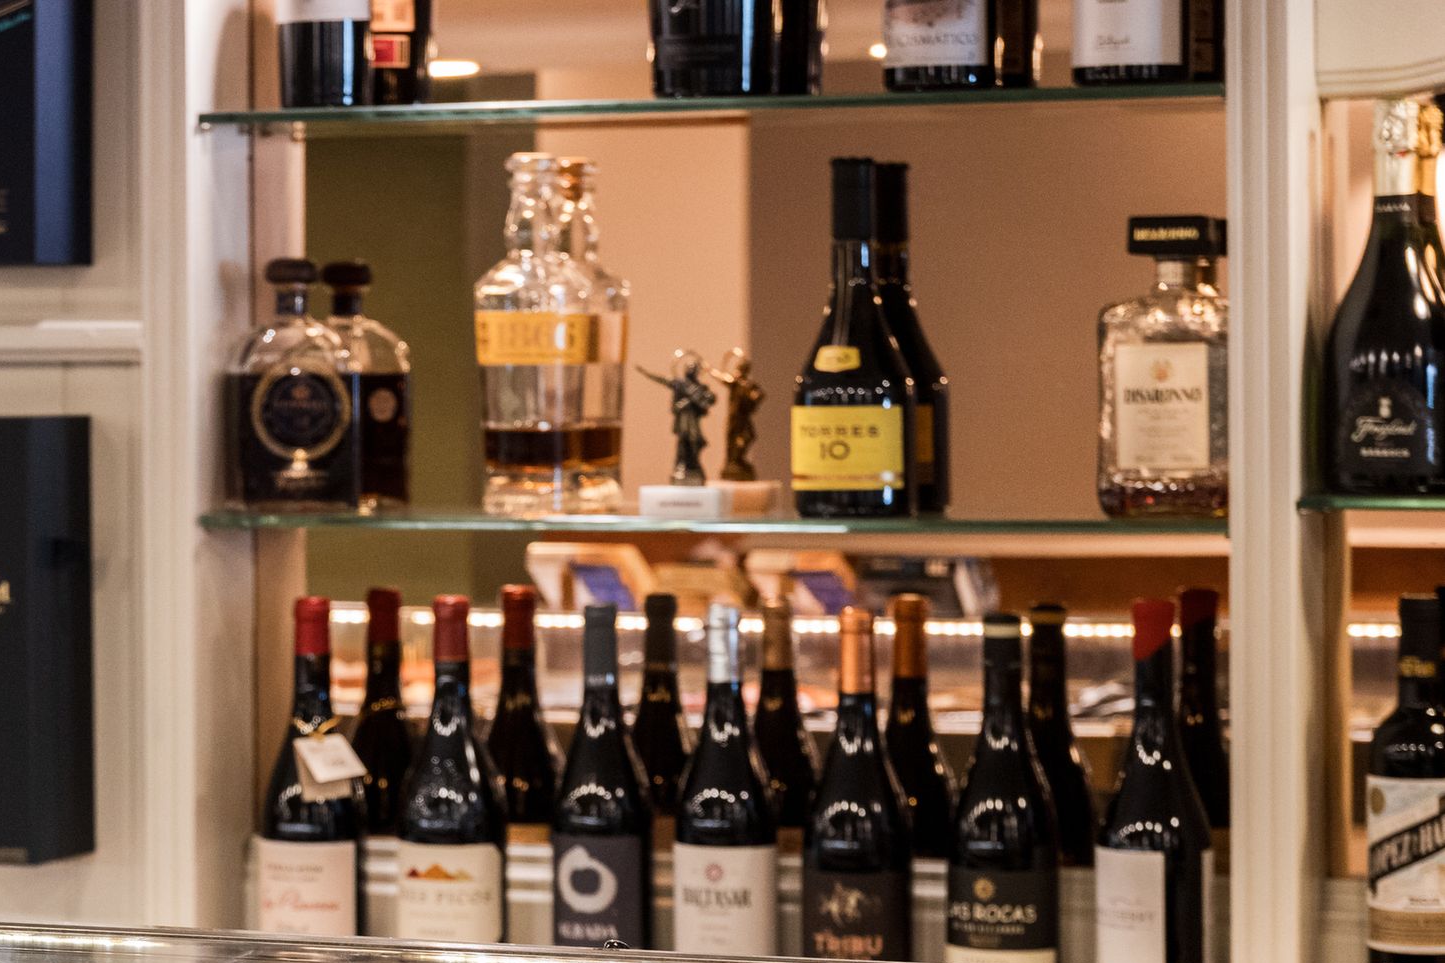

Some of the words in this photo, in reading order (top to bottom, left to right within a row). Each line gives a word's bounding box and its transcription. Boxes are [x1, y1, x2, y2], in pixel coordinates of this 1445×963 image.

[801, 424, 880, 438] TORRES
[820, 439, 851, 461] 10
[972, 903, 1038, 924] ROCAS
